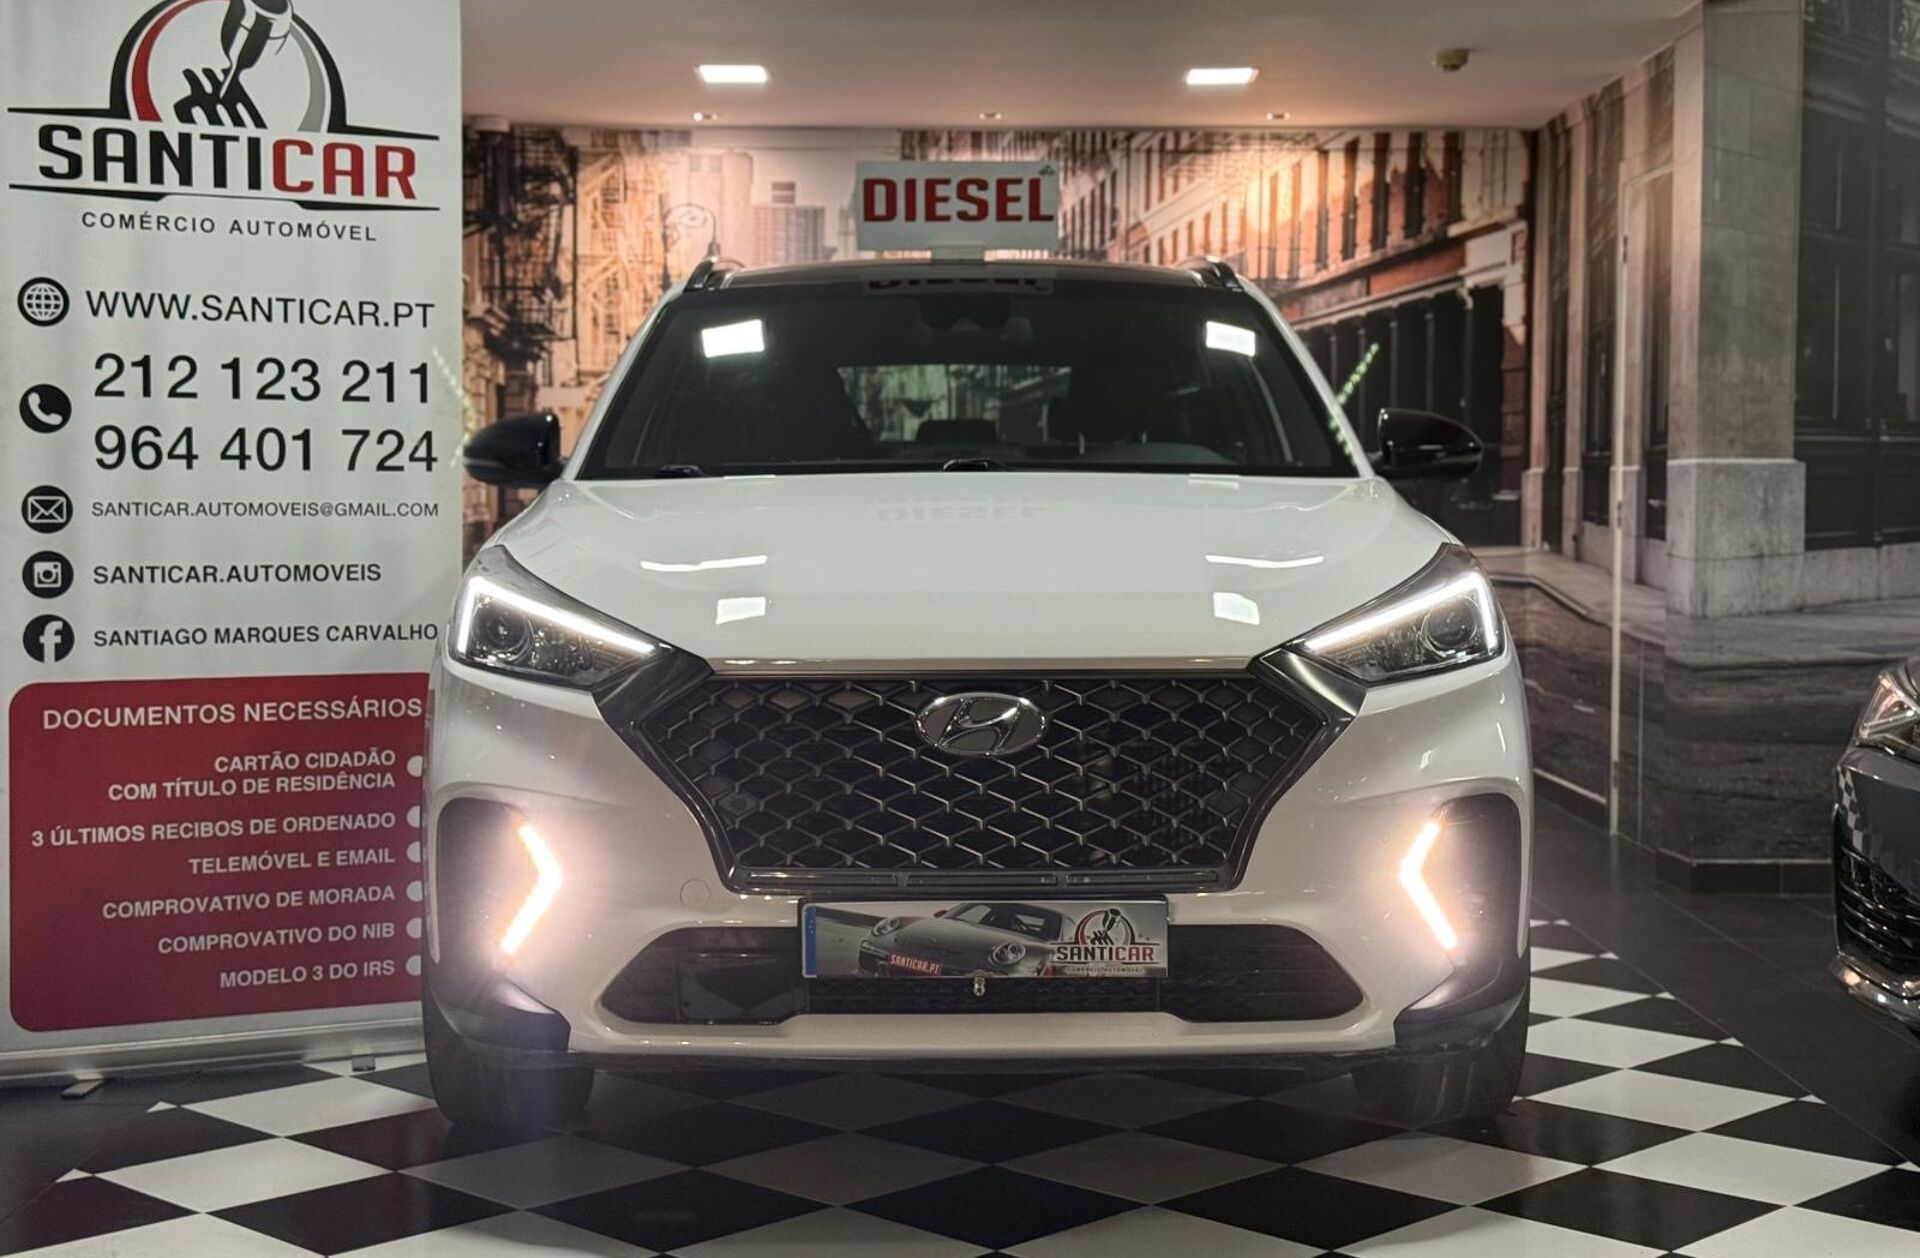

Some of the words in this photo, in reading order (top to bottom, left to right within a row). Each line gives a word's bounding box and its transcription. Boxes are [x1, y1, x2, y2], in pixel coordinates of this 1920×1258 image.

[39, 124, 417, 200] SANTICAR
[863, 177, 1055, 222] DIESEL
[82, 212, 215, 233] COMÉRCIO
[229, 219, 376, 241] AUTOMÓVEL
[86, 290, 435, 328] WWW.SANTICAR.PT
[94, 352, 198, 399] 212
[220, 356, 321, 401] 123
[341, 360, 429, 403] 211
[94, 424, 199, 471] 964
[220, 427, 312, 471] 401
[341, 429, 438, 472] 724
[92, 501, 438, 517] SANTICAR.AUTOMOVEIS@GMAIL.COM
[93, 563, 382, 584] SANTICAR.AUTOMOVEIS
[94, 628, 207, 646] SANTIAGO
[214, 626, 320, 644] MARQUES
[326, 624, 438, 641] CARVALHO
[43, 704, 236, 730] DOCUMENTOS
[244, 696, 422, 723] NECESSÁRIOS
[214, 750, 299, 773] CARTÃO
[305, 747, 396, 769] CIDADÃO
[108, 784, 156, 801] COM
[163, 776, 236, 799] TÍTULO
[243, 777, 270, 794] DE
[276, 771, 395, 793] RESIDÊNCIA
[32, 830, 44, 847] 3
[51, 824, 145, 846] ÚLTIMOS
[152, 820, 244, 840] RECIBOS
[250, 818, 276, 835] DE
[282, 812, 395, 834] ORDENADO
[189, 850, 311, 874] TELEMÓVEL
[318, 852, 329, 867] E
[336, 847, 395, 866] EMAIL
[103, 893, 269, 919] COMPROVATIVO
[276, 890, 303, 907] DE
[309, 885, 395, 905] MORADA
[158, 928, 322, 954] COMPROVATIVO
[328, 926, 356, 943] DO
[363, 923, 395, 939] NIB
[1056, 946, 1154, 961] SANTICAR
[220, 966, 307, 989] MODELO
[312, 963, 323, 980] 3
[329, 962, 357, 979] DO
[364, 960, 395, 977] IRS
